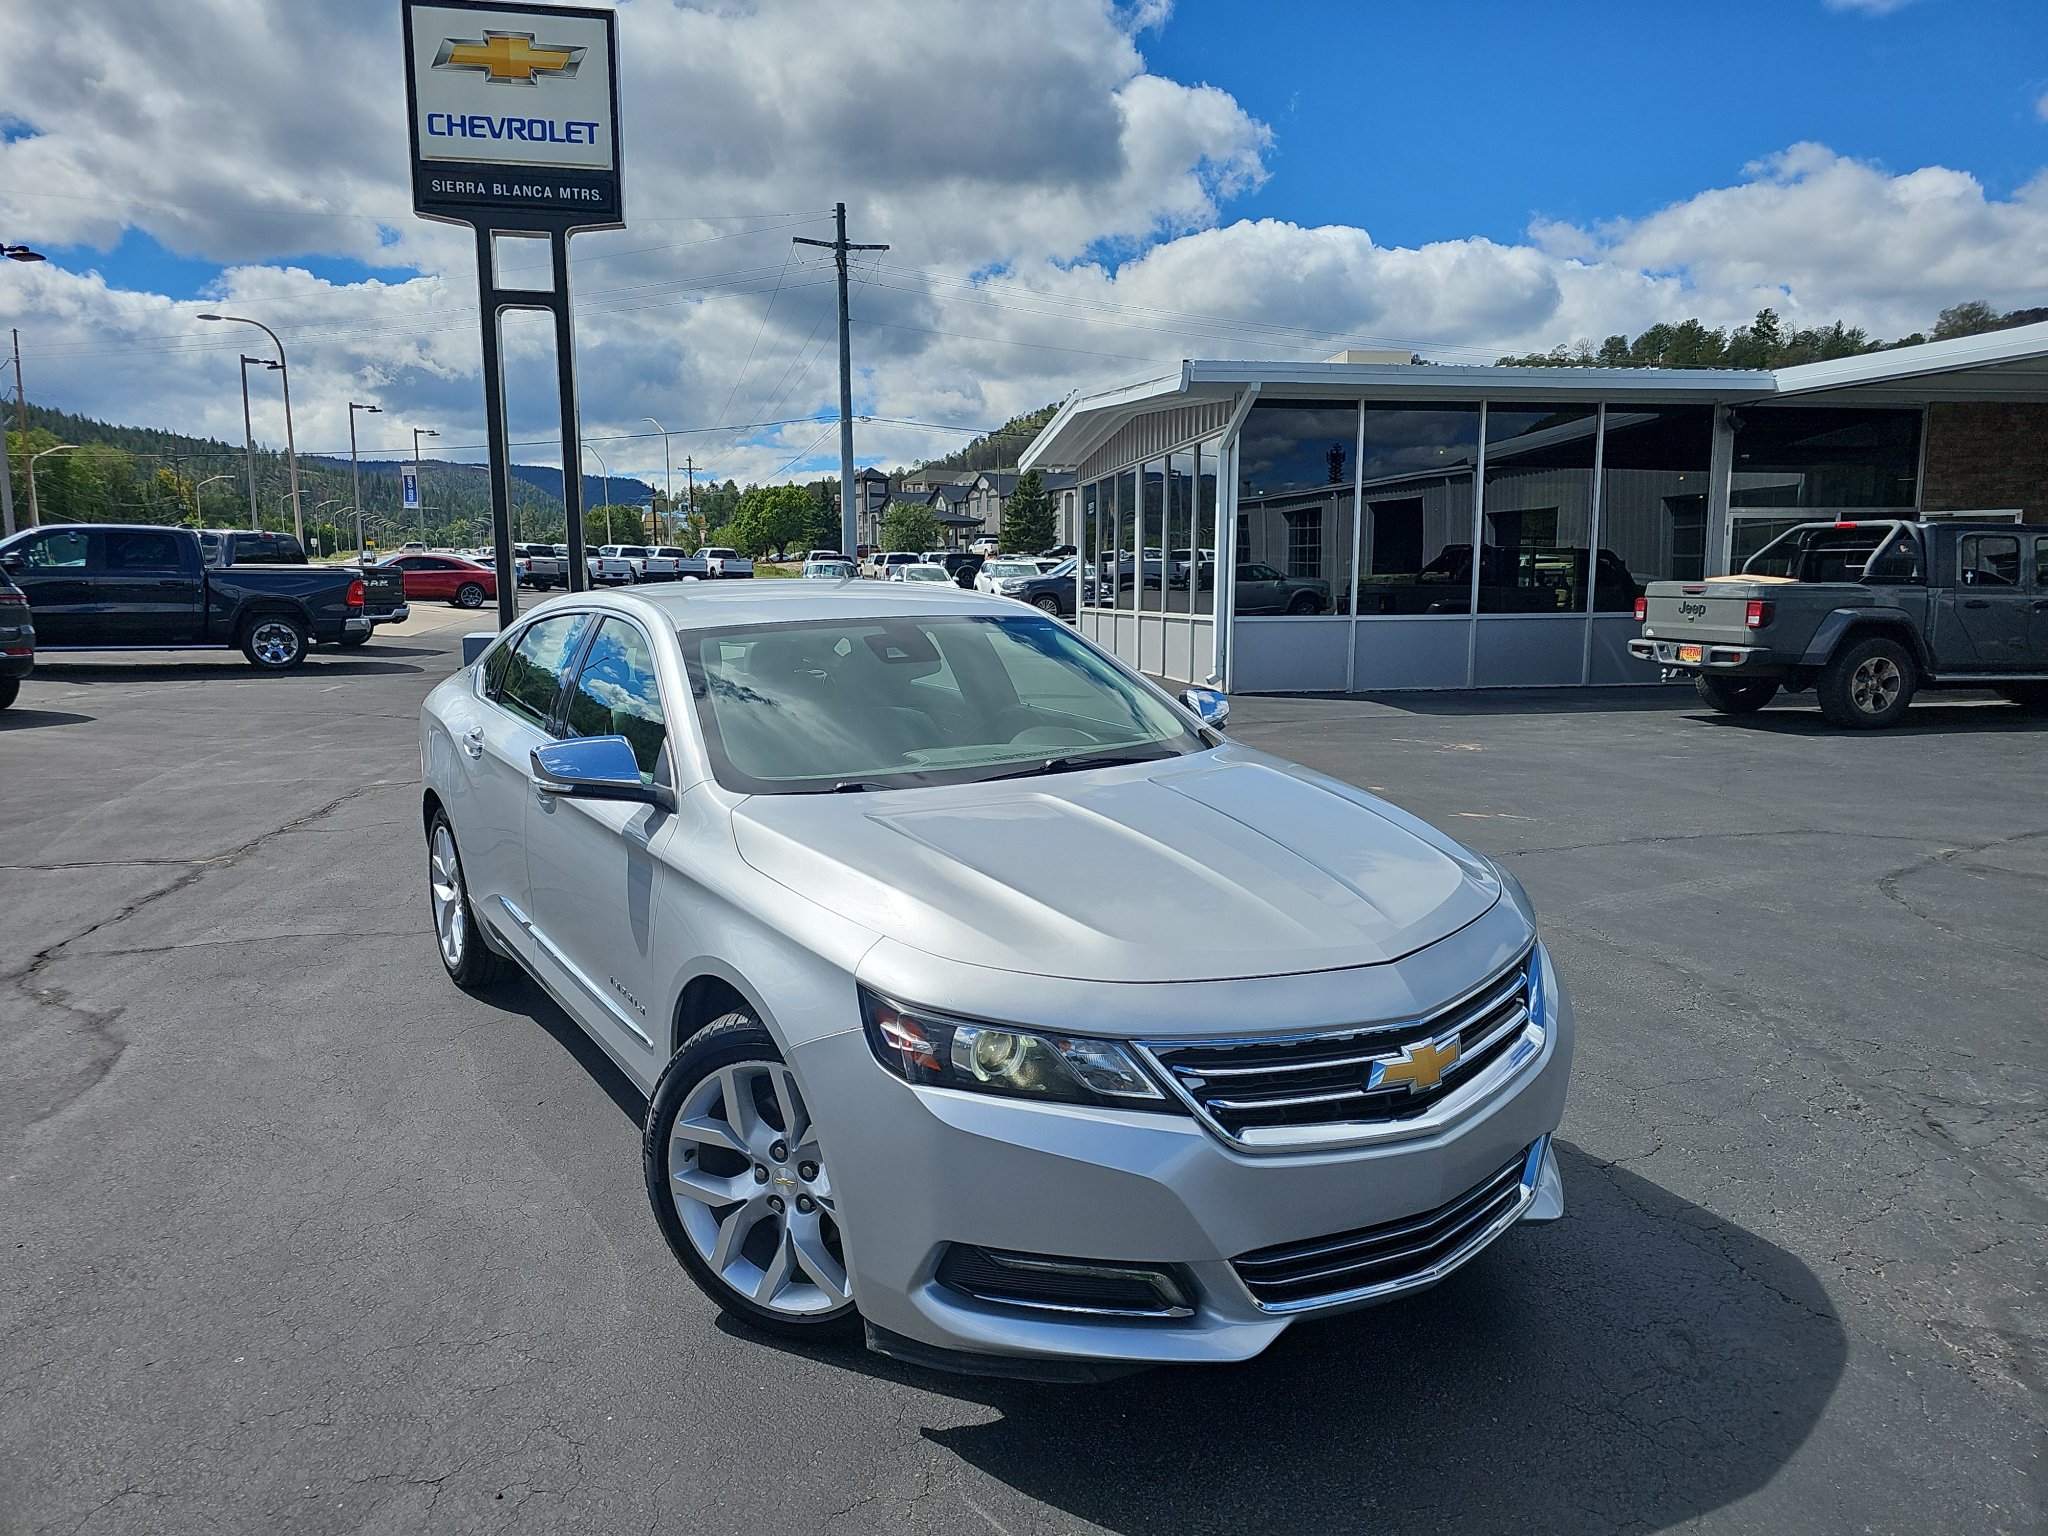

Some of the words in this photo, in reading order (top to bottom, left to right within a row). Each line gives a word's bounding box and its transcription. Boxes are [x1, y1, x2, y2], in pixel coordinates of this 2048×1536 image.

[427, 113, 599, 145] CHEVROLET
[431, 179, 486, 195] SIERRA
[493, 183, 553, 199] BLANCA
[1678, 600, 1706, 617] Jeep
